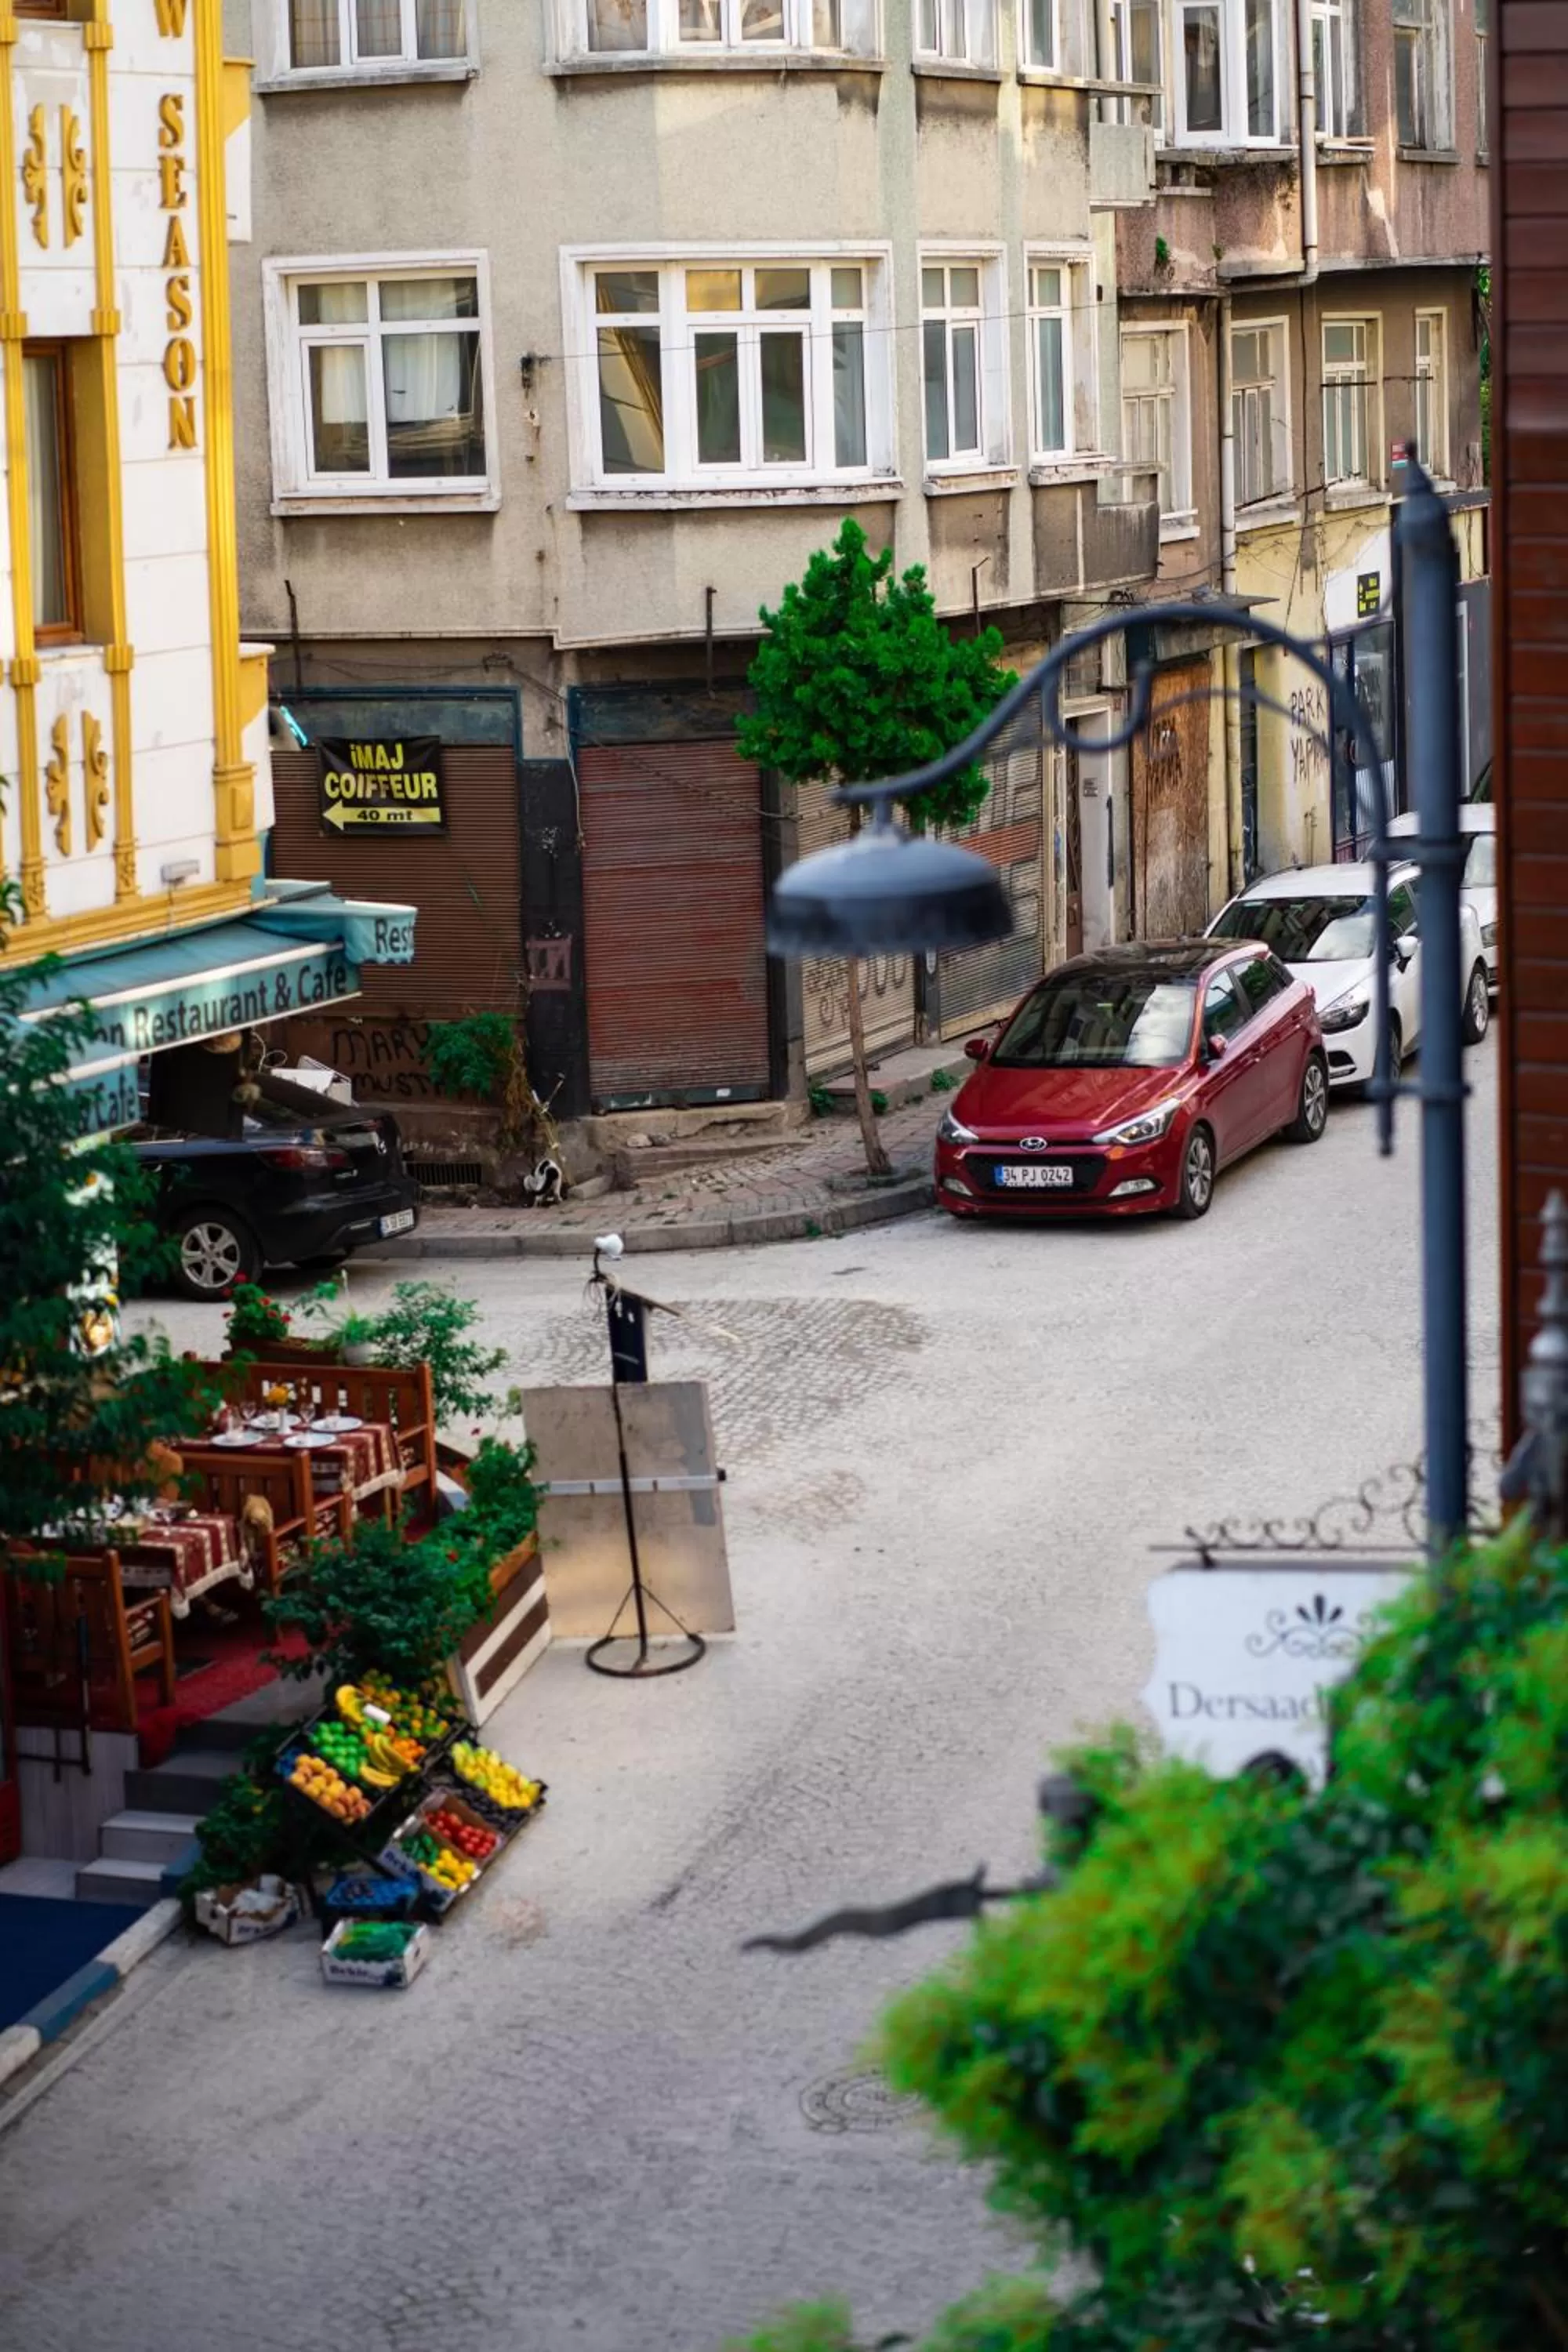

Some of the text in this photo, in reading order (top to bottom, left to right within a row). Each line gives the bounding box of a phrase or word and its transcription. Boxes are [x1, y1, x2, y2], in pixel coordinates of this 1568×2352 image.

[158, 93, 198, 450] SEASON
[1290, 685, 1325, 727] PARK
[325, 771, 438, 800] COIFFEUR
[357, 810, 413, 821] 40 mt
[134, 981, 269, 1049] Restaurant
[275, 973, 291, 1011] &
[1004, 1169, 1070, 1181] 34 PJ 0242
[1167, 1680, 1327, 1720] Dersaad
